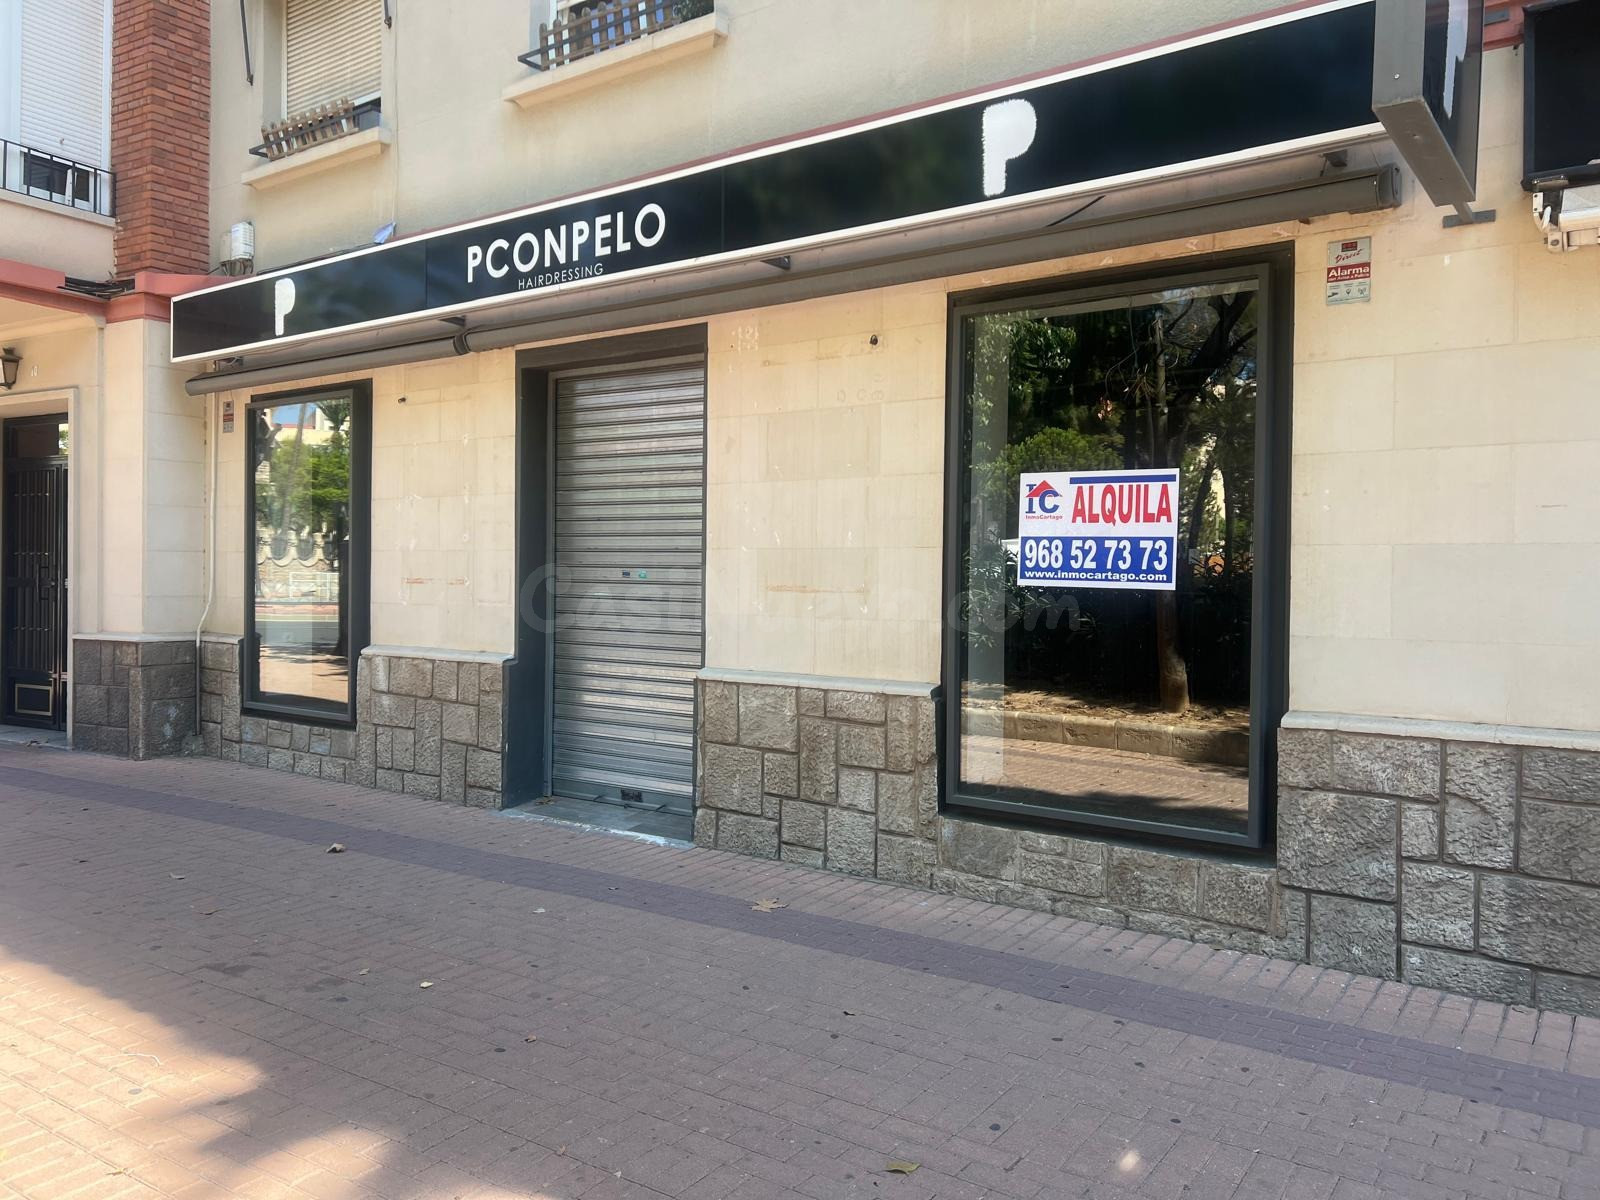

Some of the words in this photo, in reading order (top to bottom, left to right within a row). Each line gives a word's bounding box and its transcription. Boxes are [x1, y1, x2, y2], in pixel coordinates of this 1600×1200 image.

[981, 98, 1037, 197] P
[467, 203, 666, 284] PCONPELO
[518, 263, 604, 290] HAIRDRESSING
[1329, 266, 1369, 277] Alarma
[274, 278, 296, 336] P
[1071, 484, 1172, 527] ALQUILA
[1024, 539, 1063, 569] 968
[1069, 539, 1097, 569] 52
[1104, 540, 1132, 570] 73
[1139, 540, 1168, 571] 73
[1024, 570, 1167, 582] www.inmocartago.com
